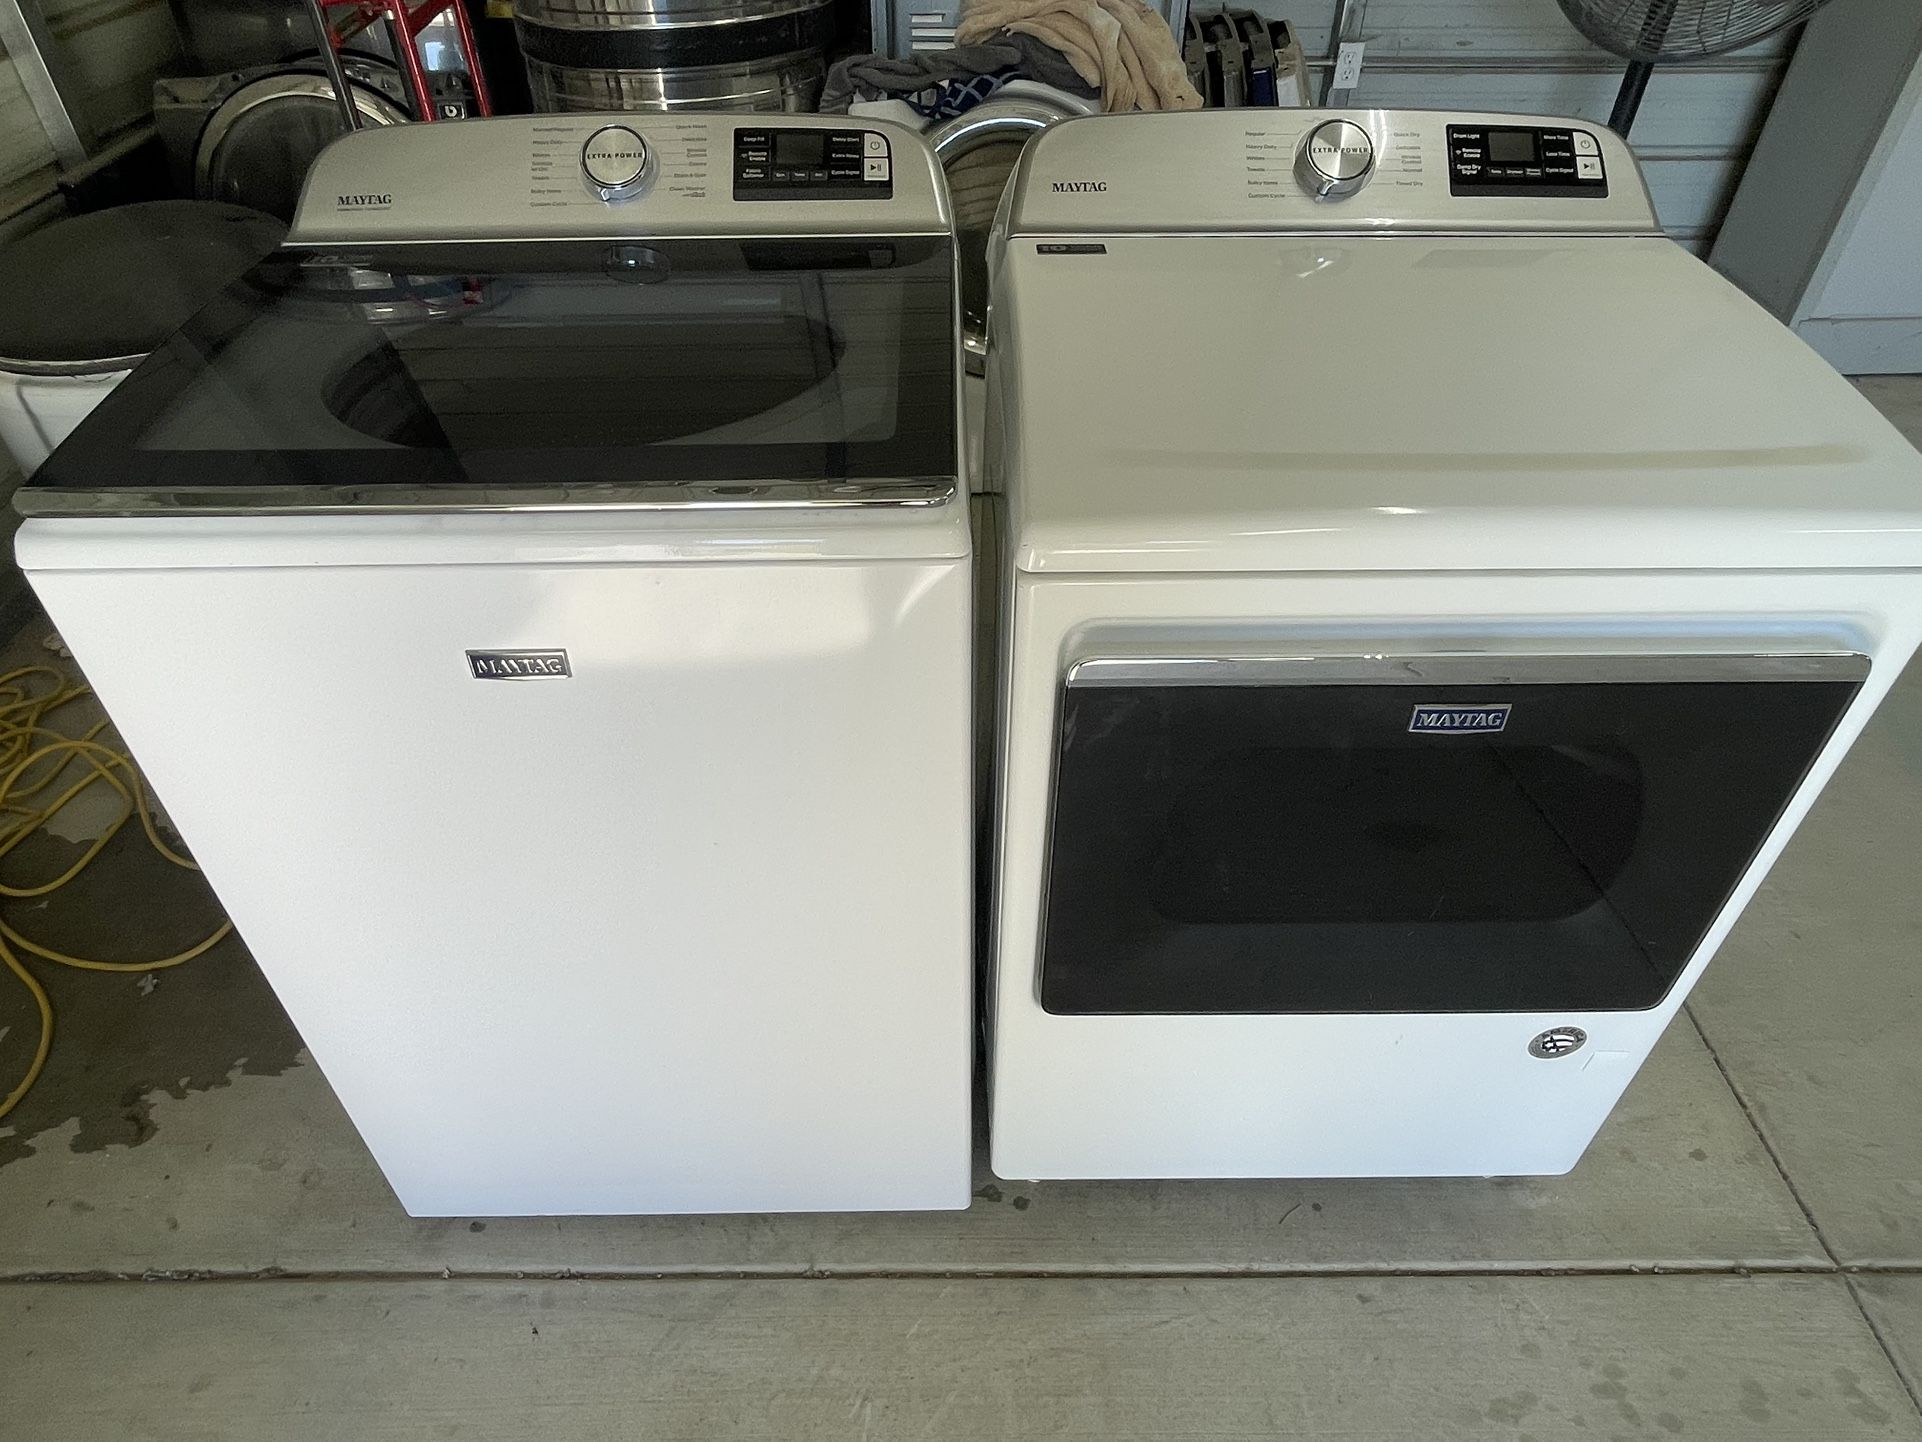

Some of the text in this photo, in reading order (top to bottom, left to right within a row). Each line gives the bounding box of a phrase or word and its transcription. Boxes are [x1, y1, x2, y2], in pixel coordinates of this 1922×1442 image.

[587, 152, 612, 160] EXTRA
[1052, 182, 1107, 192] MAYTAG
[337, 194, 392, 206] MAYTAG
[476, 658, 563, 674] MAYTAG
[1416, 712, 1503, 727] MAYTAG
